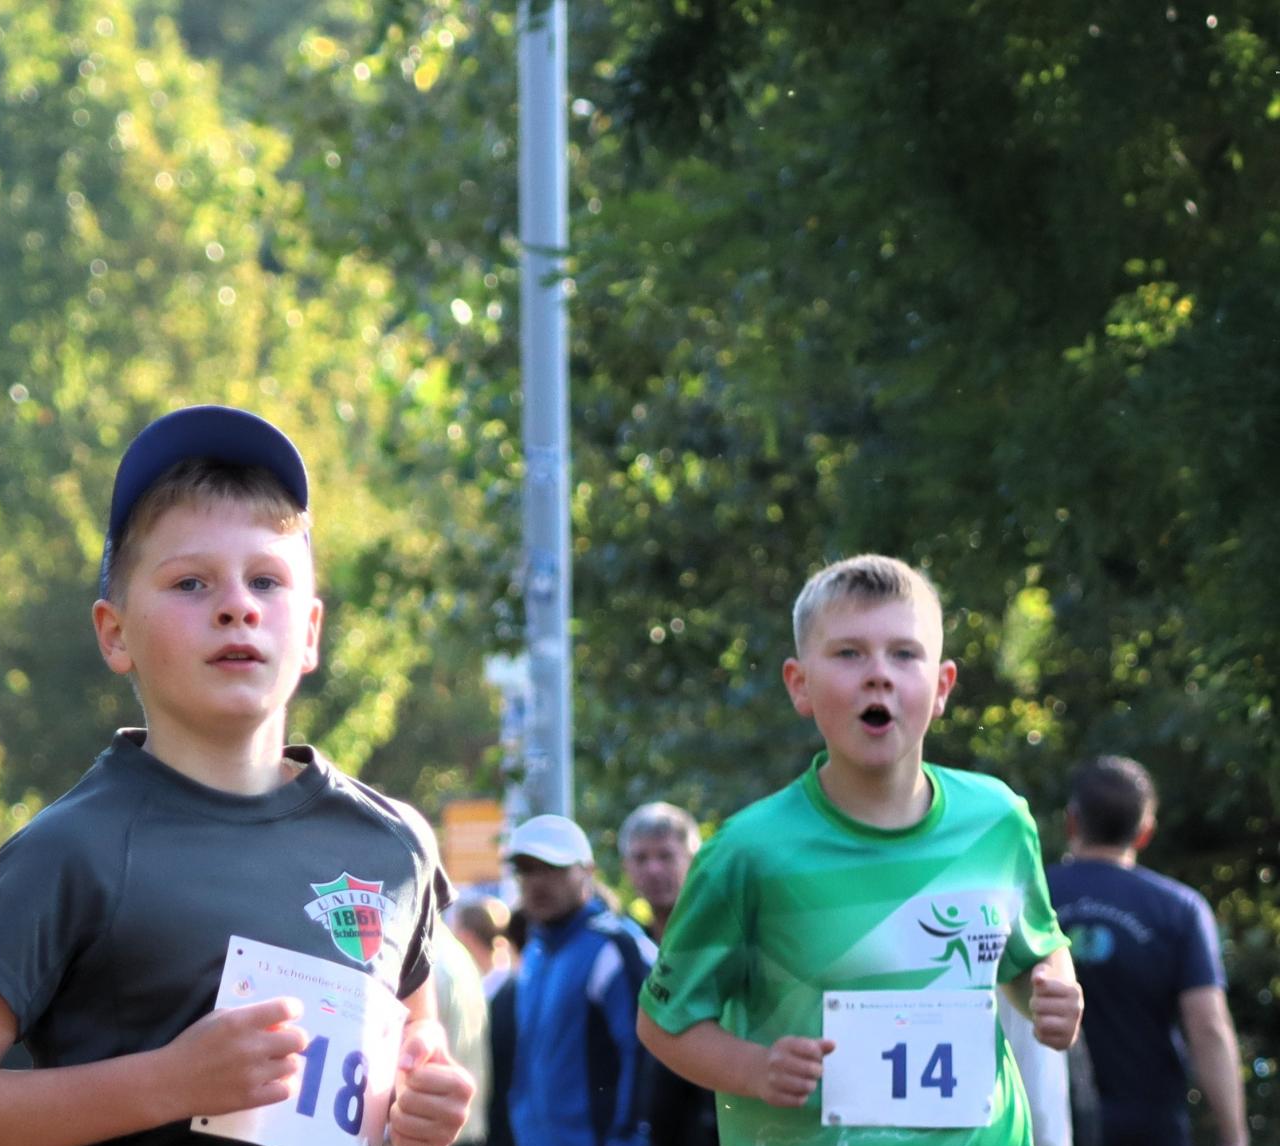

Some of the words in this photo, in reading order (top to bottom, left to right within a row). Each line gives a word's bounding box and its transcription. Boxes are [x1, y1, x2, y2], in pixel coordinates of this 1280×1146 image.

[317, 892, 387, 911] UNION
[332, 910, 377, 927] 1861
[296, 1034, 369, 1137] 18
[881, 1042, 958, 1099] 14
